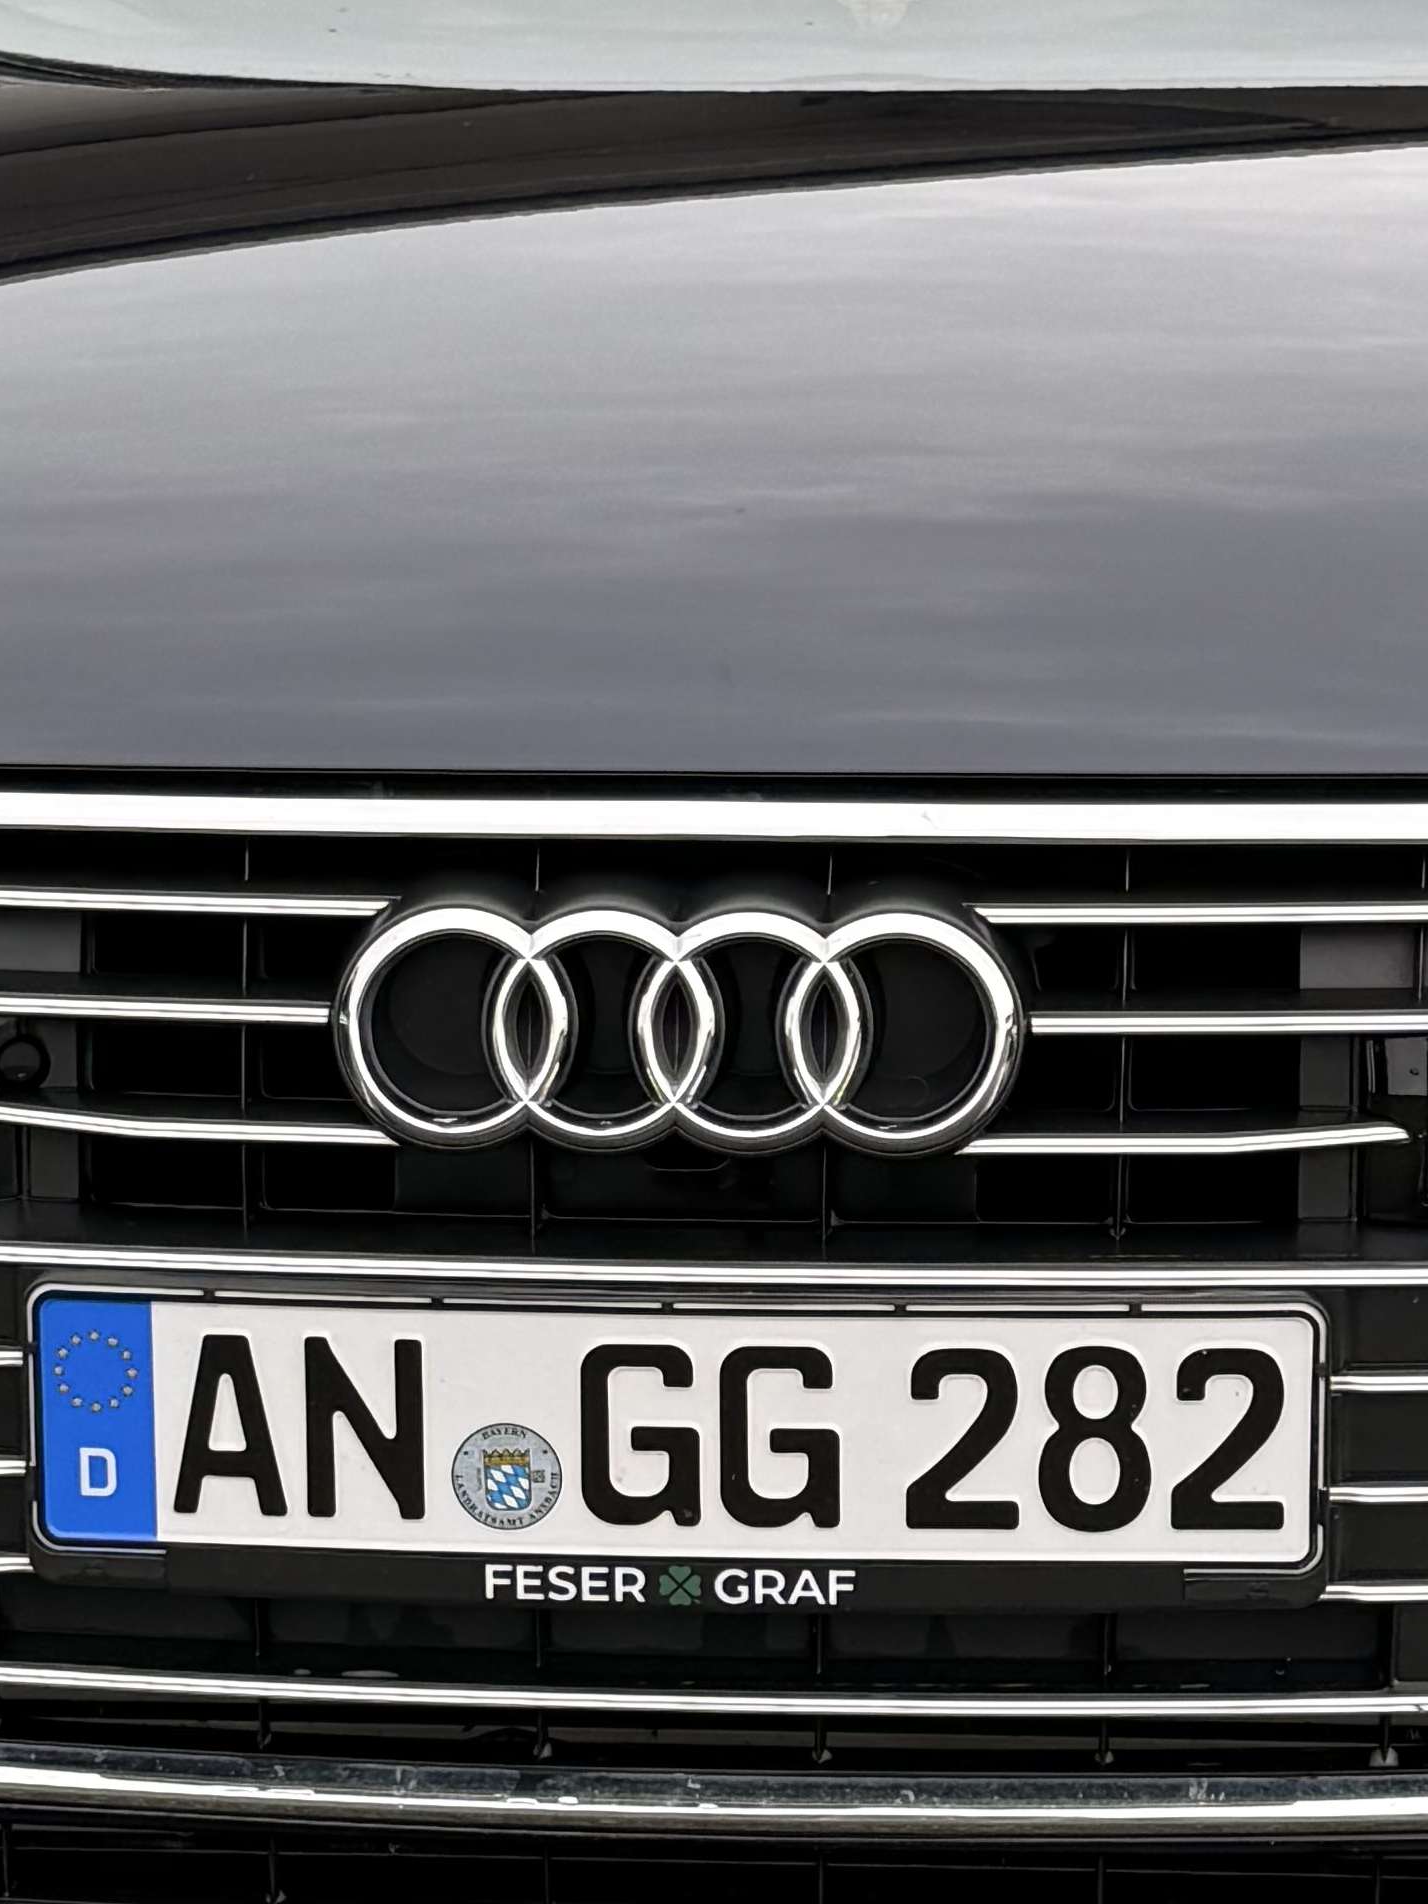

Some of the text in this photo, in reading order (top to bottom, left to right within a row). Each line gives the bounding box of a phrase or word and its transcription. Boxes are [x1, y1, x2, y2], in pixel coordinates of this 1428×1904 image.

[173, 1333, 1286, 1533] AN GG 282
[481, 1427, 527, 1440] BAYERN
[80, 1447, 117, 1496] D
[484, 1564, 856, 1607] FESER GRAF
